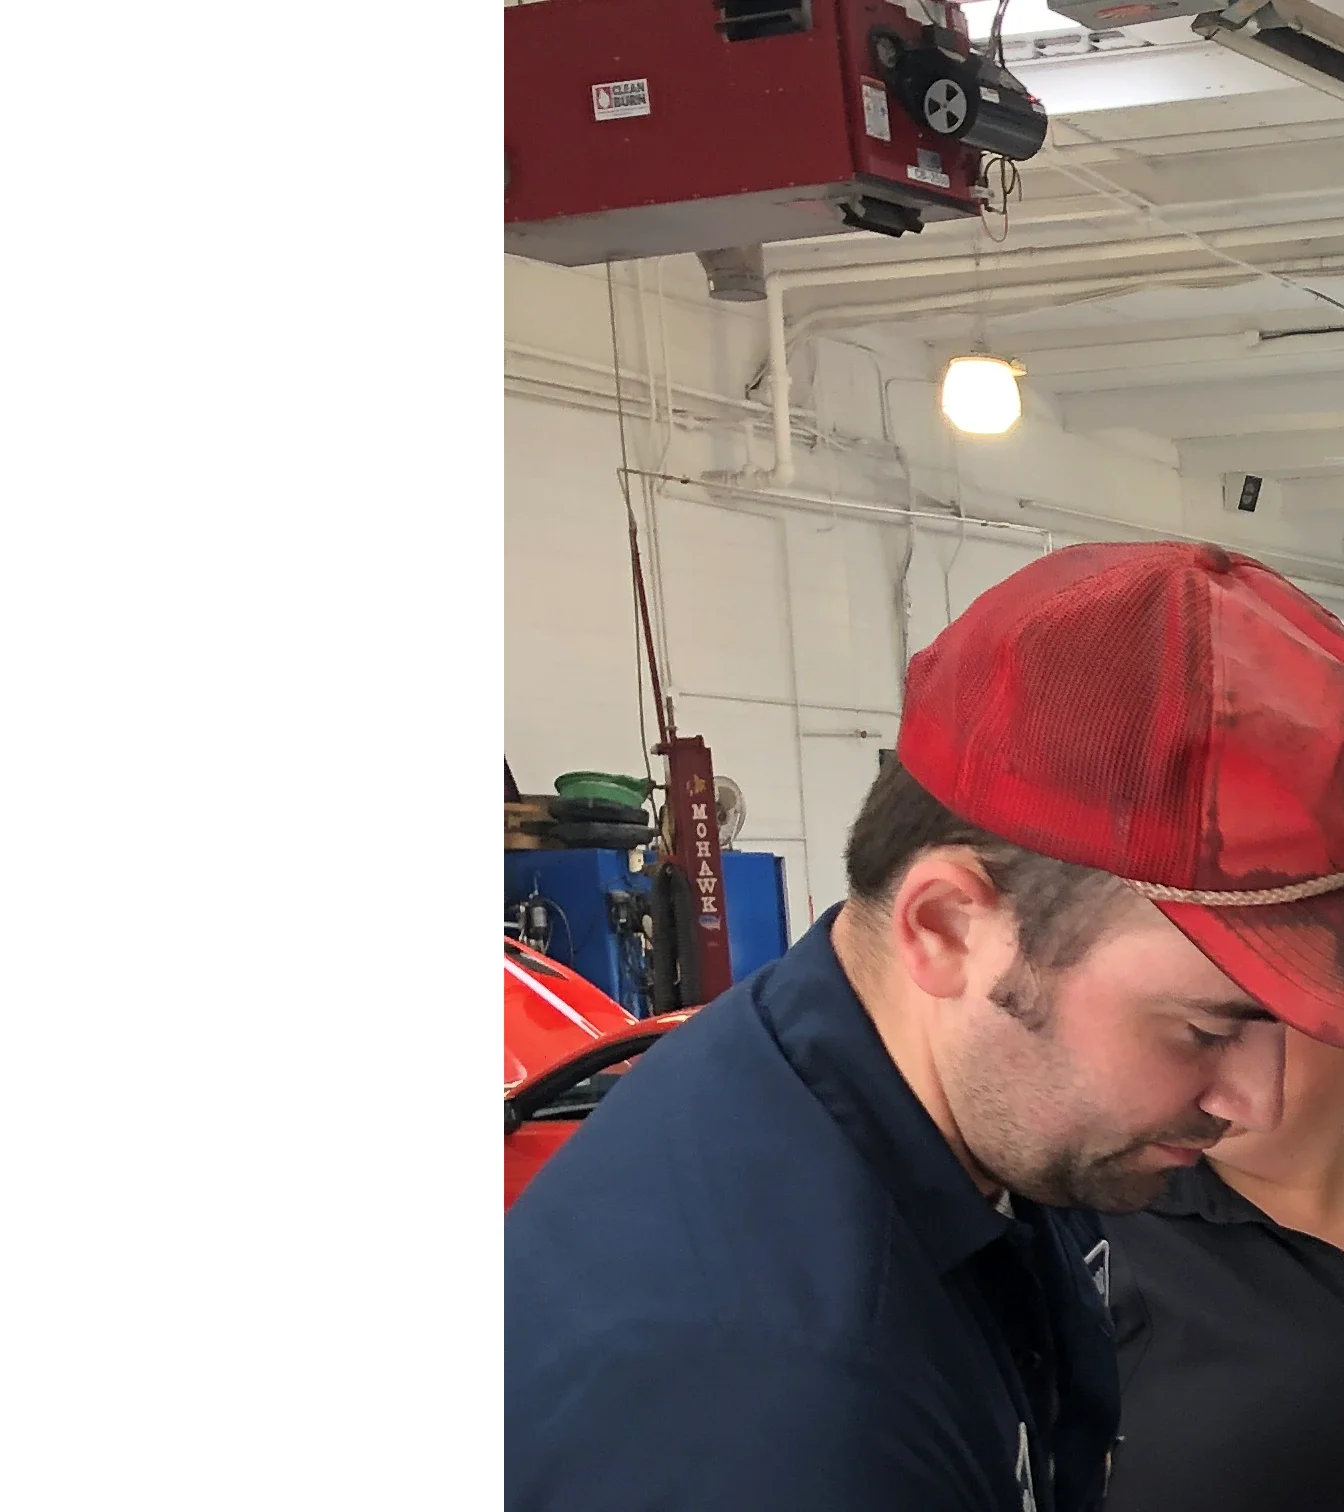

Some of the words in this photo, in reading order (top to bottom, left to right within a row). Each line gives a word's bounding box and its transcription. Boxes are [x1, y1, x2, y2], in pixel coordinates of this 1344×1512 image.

[612, 82, 645, 95] CLEAN
[614, 94, 647, 107] BURN
[691, 803, 718, 913] MOHAWK
